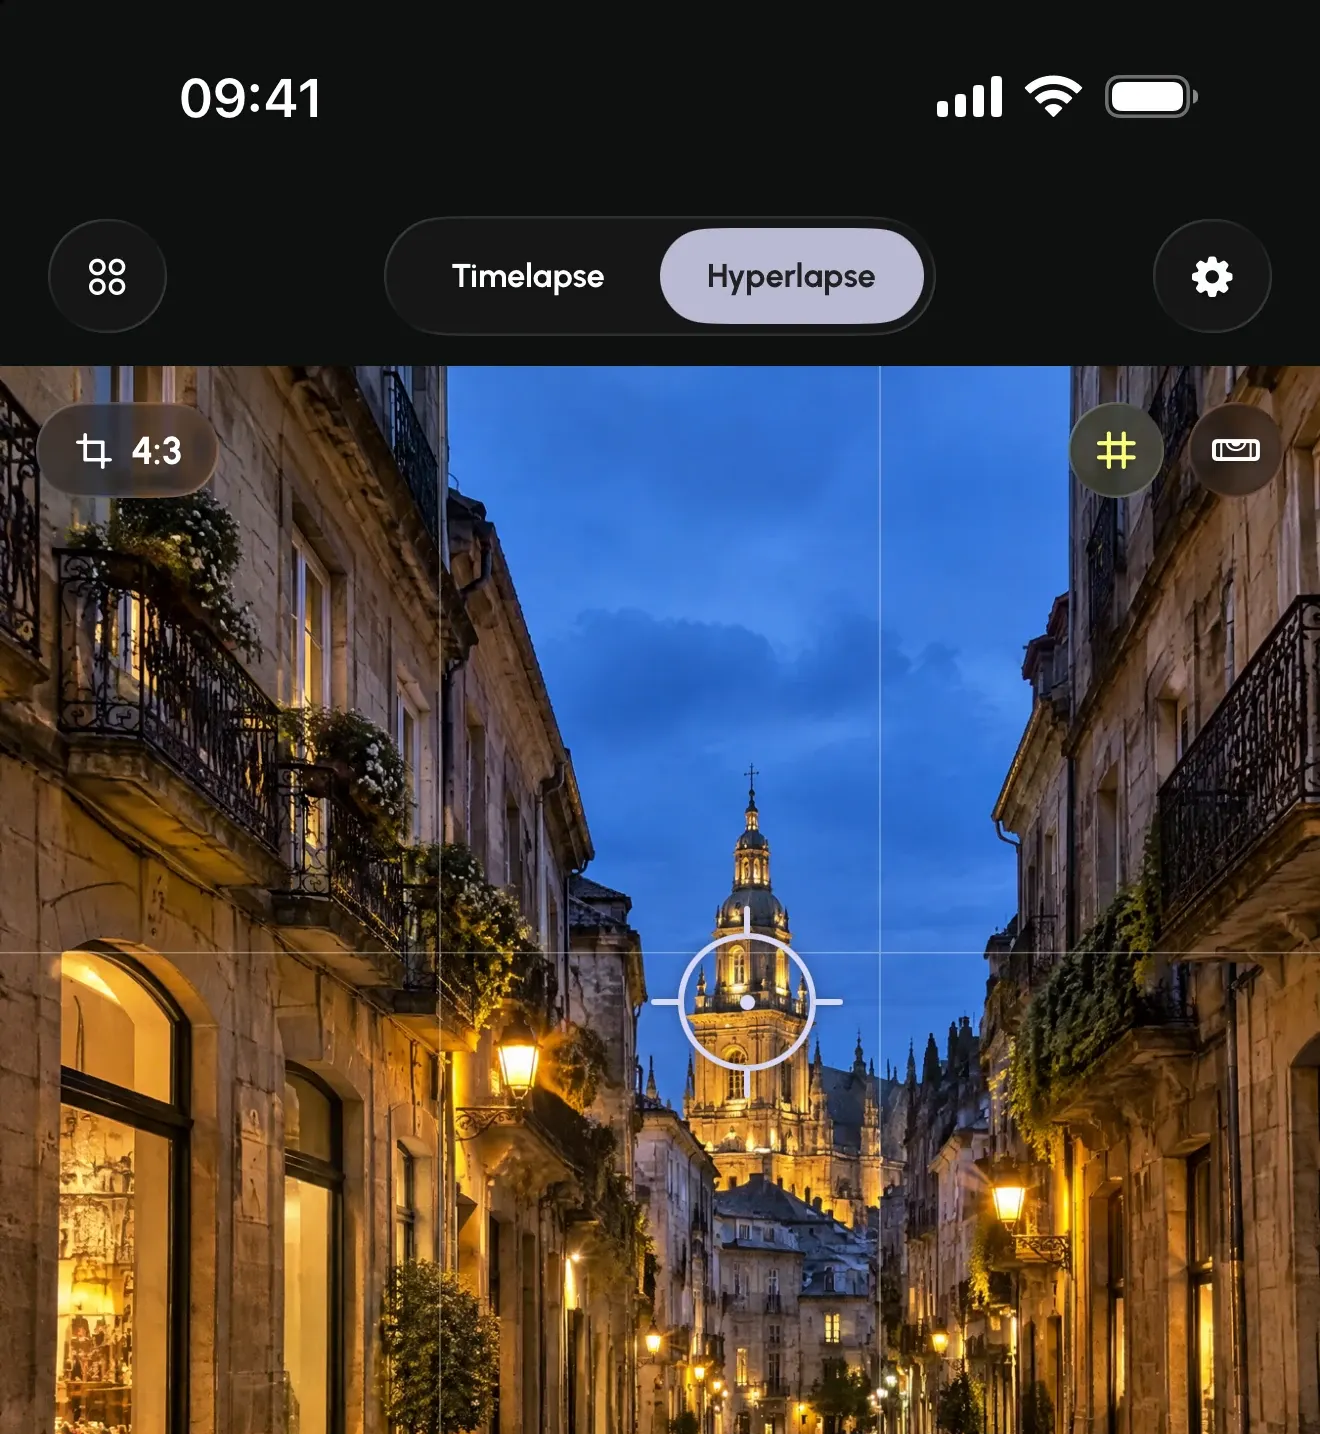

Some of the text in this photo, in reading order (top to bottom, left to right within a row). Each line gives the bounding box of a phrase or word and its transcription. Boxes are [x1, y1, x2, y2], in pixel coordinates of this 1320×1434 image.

[180, 77, 319, 119] 09:41
[451, 261, 605, 296] Timelapse
[707, 261, 876, 296] Hyperlapse
[132, 435, 182, 465] 4:3
